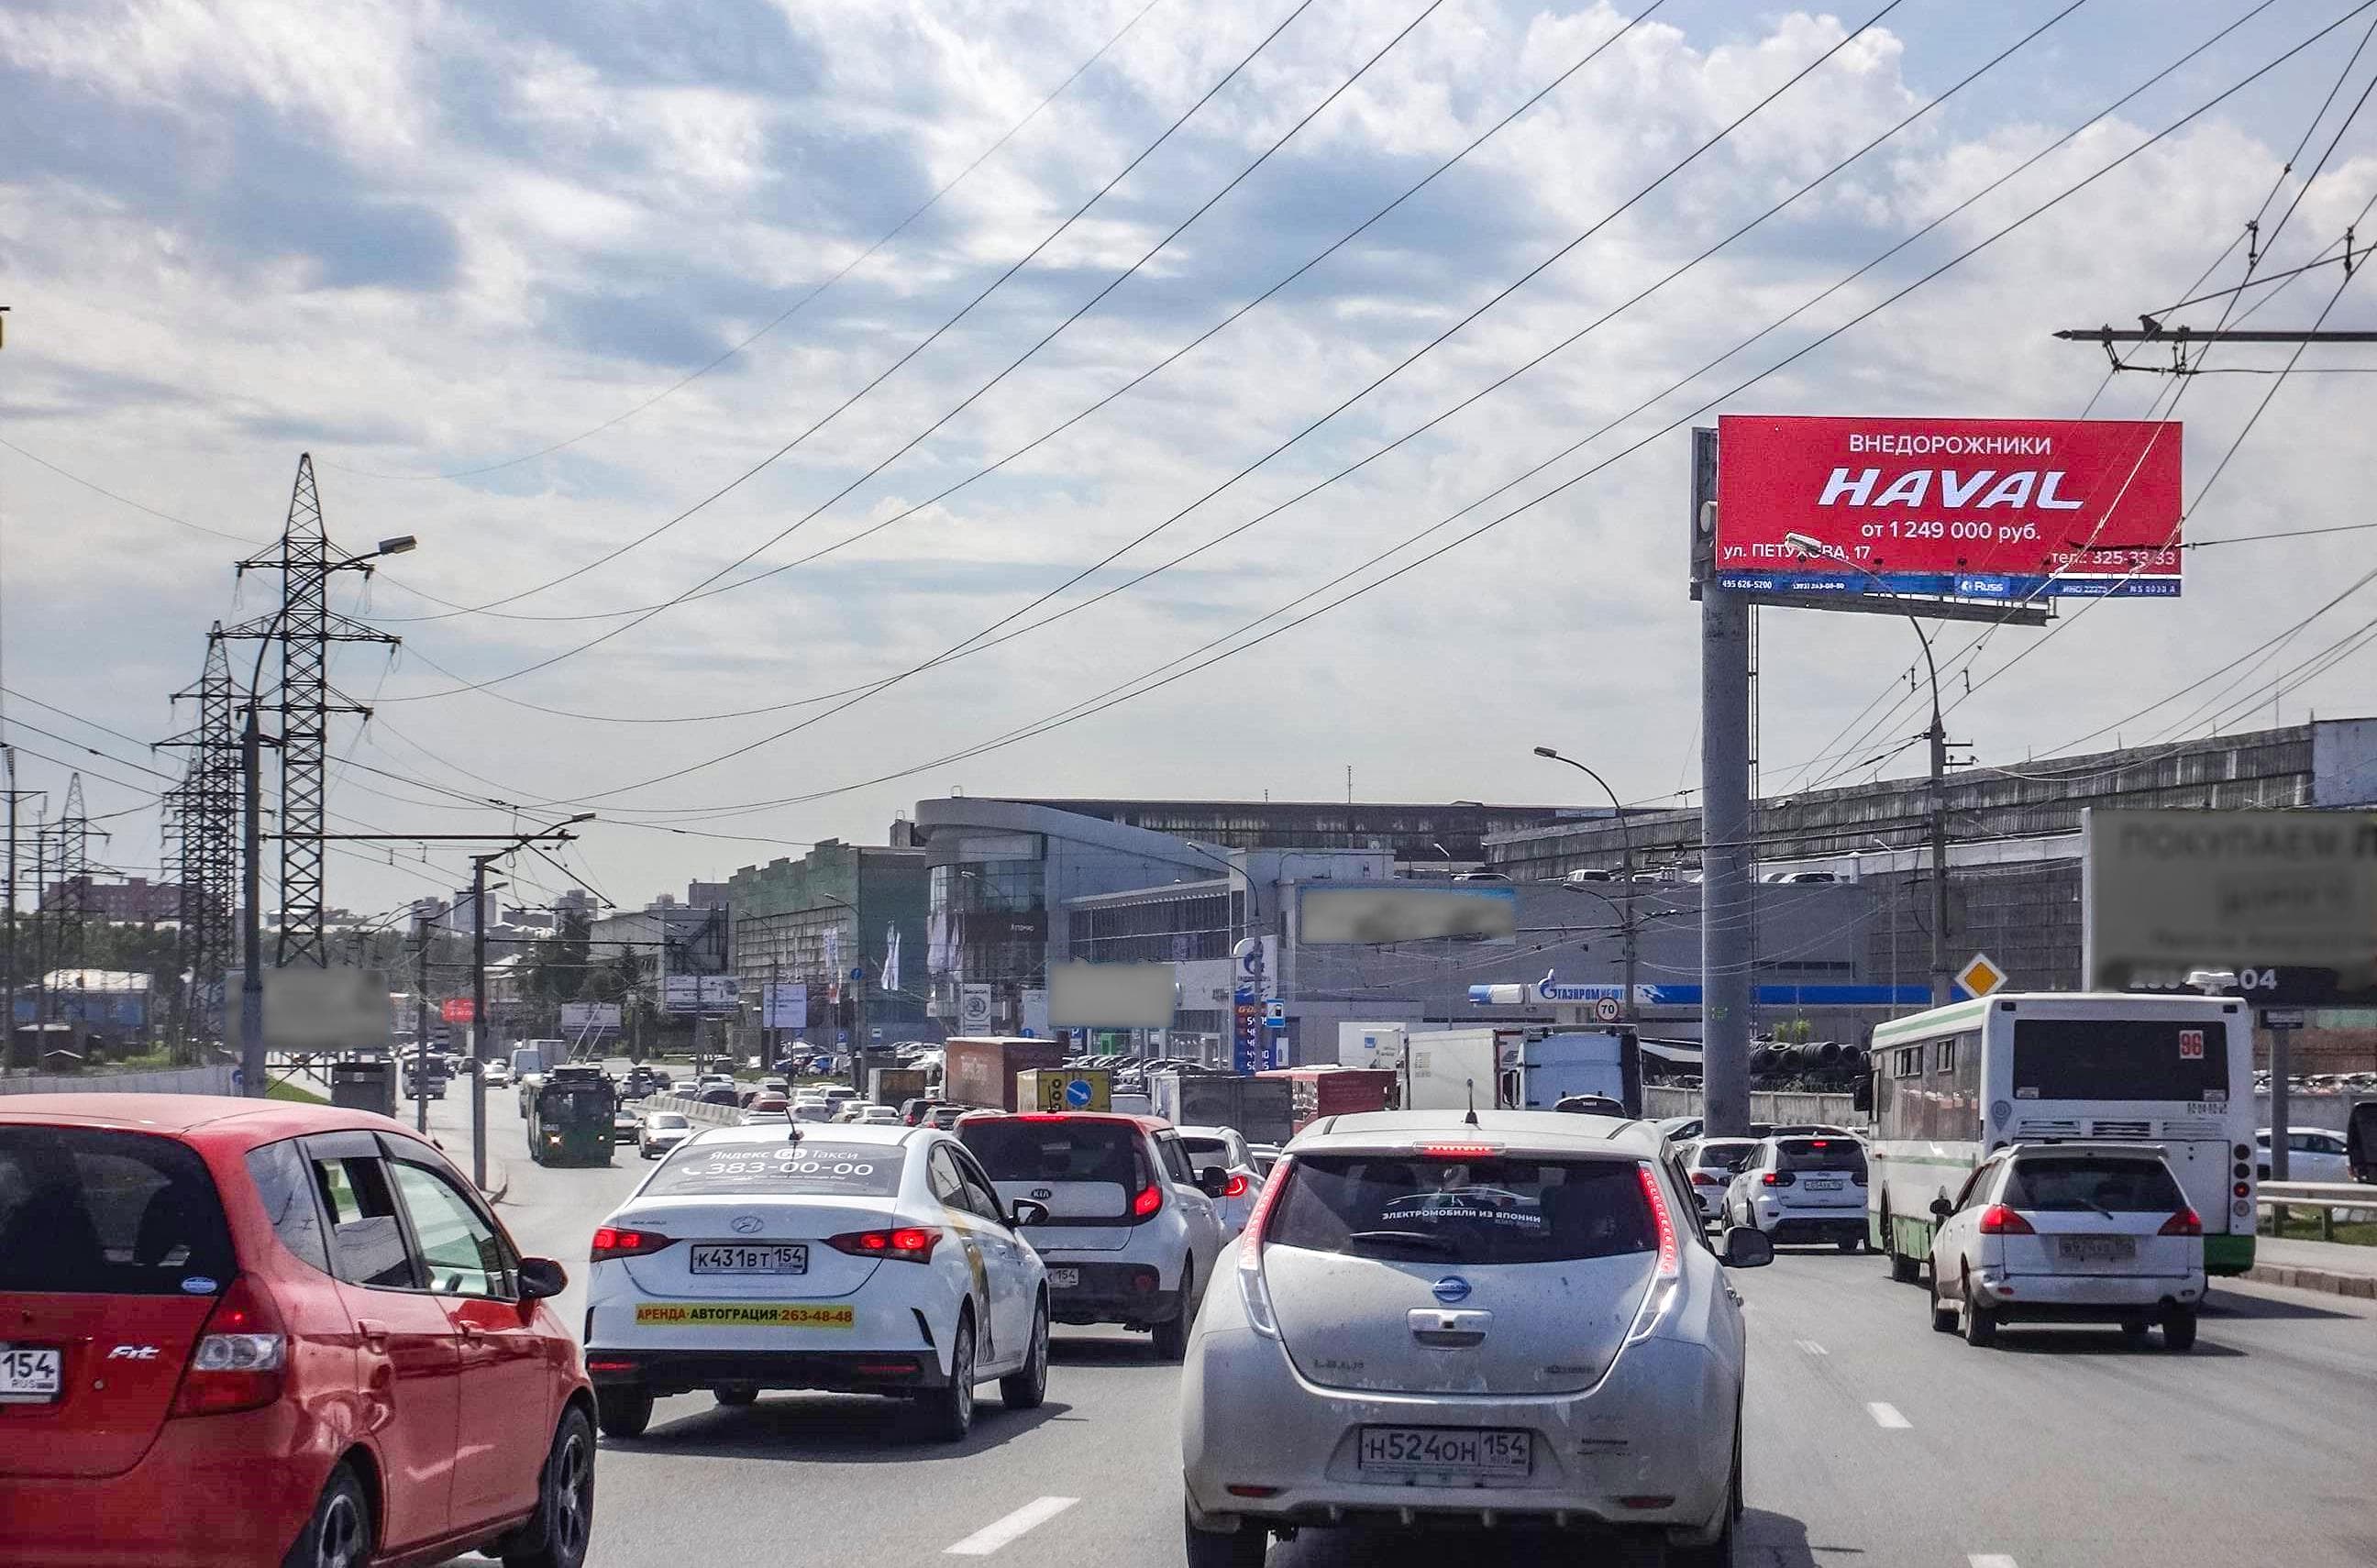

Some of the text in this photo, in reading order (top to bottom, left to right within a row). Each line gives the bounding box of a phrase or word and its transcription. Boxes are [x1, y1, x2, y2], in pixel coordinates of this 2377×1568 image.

[1849, 434, 2051, 456] ВНЕДОРОЖНИКИ
[1817, 467, 2084, 510] HAVAL
[1862, 520, 2040, 544] от 1 249 000 руб.
[1723, 545, 1747, 560] ул.
[1854, 546, 1871, 559] 17
[1973, 580, 2004, 592] Russ
[1600, 1004, 1616, 1015] 70
[709, 1151, 768, 1161] Яндекс
[813, 1150, 858, 1160] Такси
[705, 1161, 874, 1176] 383-00-00
[1382, 1209, 1542, 1223] ЭЛЕКТРОМОБИЛИ ИЗ ЯПОНИИ
[774, 1247, 802, 1263] 154
[781, 1309, 853, 1322] 263-48-48
[2, 1353, 55, 1379] 154
[1483, 1432, 1527, 1456] 154
